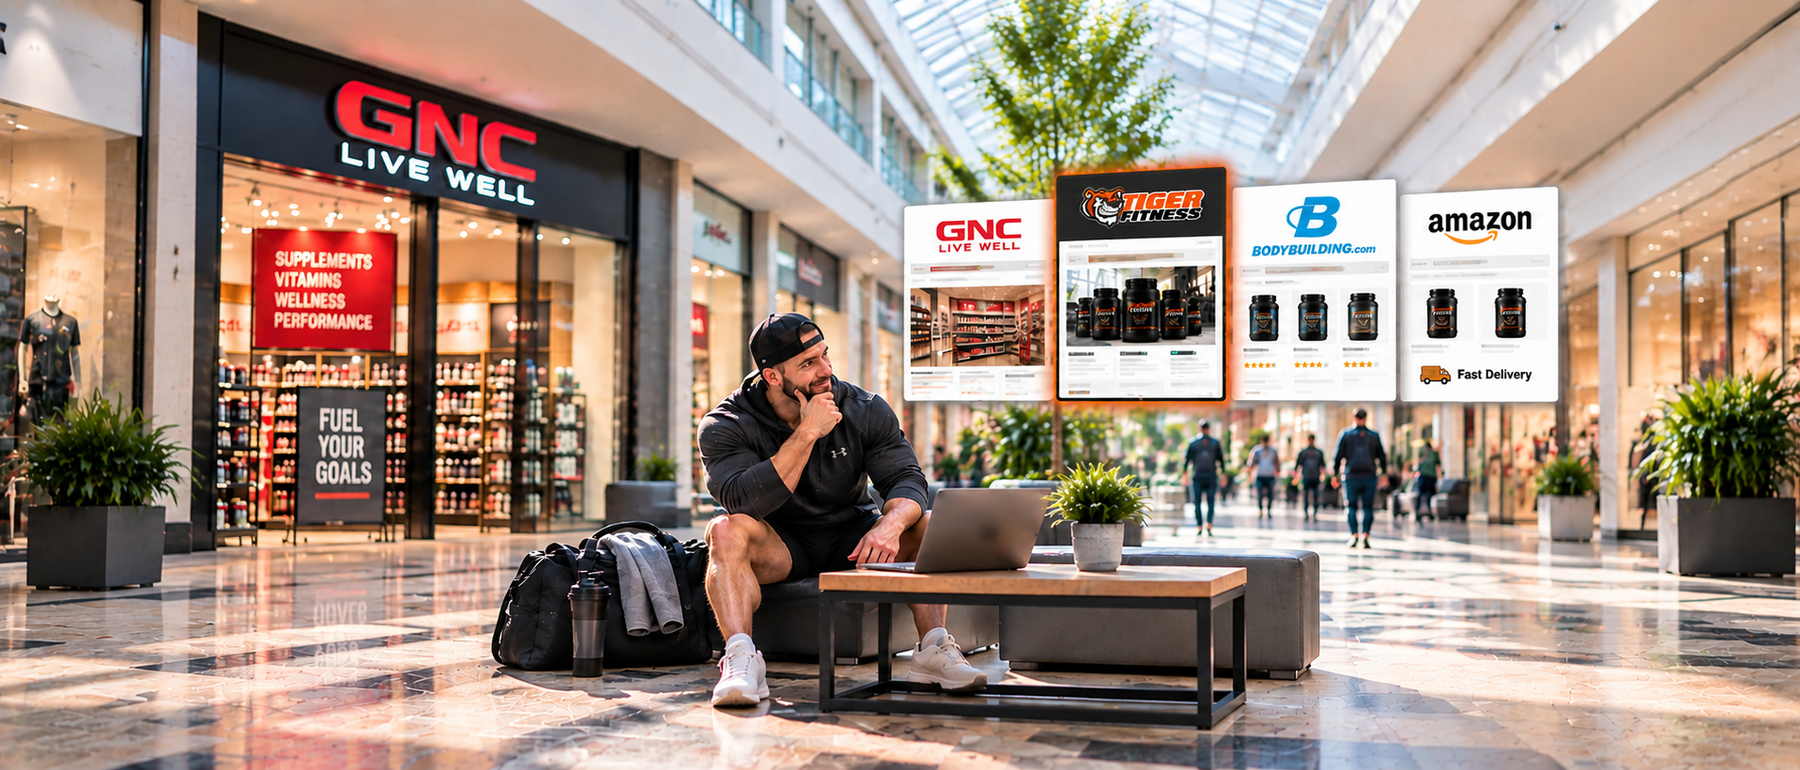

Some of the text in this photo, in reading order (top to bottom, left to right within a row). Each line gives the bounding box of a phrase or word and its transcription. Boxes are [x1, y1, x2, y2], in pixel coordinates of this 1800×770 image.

[336, 80, 537, 183] GNC
[341, 142, 536, 207] LIVE WELL
[1121, 190, 1206, 211] TIGER
[1119, 206, 1205, 223] FITNESS
[1428, 210, 1532, 233] amazon
[936, 218, 1022, 242] GNC
[938, 241, 1021, 253] LIVE WELL
[1251, 243, 1377, 257] BODYBUILDING.com
[274, 250, 374, 271] SUPPLEMENTS
[274, 271, 342, 289] VITAMINS
[274, 291, 346, 310] WELLNESS
[273, 311, 374, 331] PERFORMANCE
[1457, 368, 1533, 383] Fast Delivery
[318, 407, 364, 434] FUEL
[317, 434, 365, 459] YOUR
[314, 460, 373, 486] GOALS
